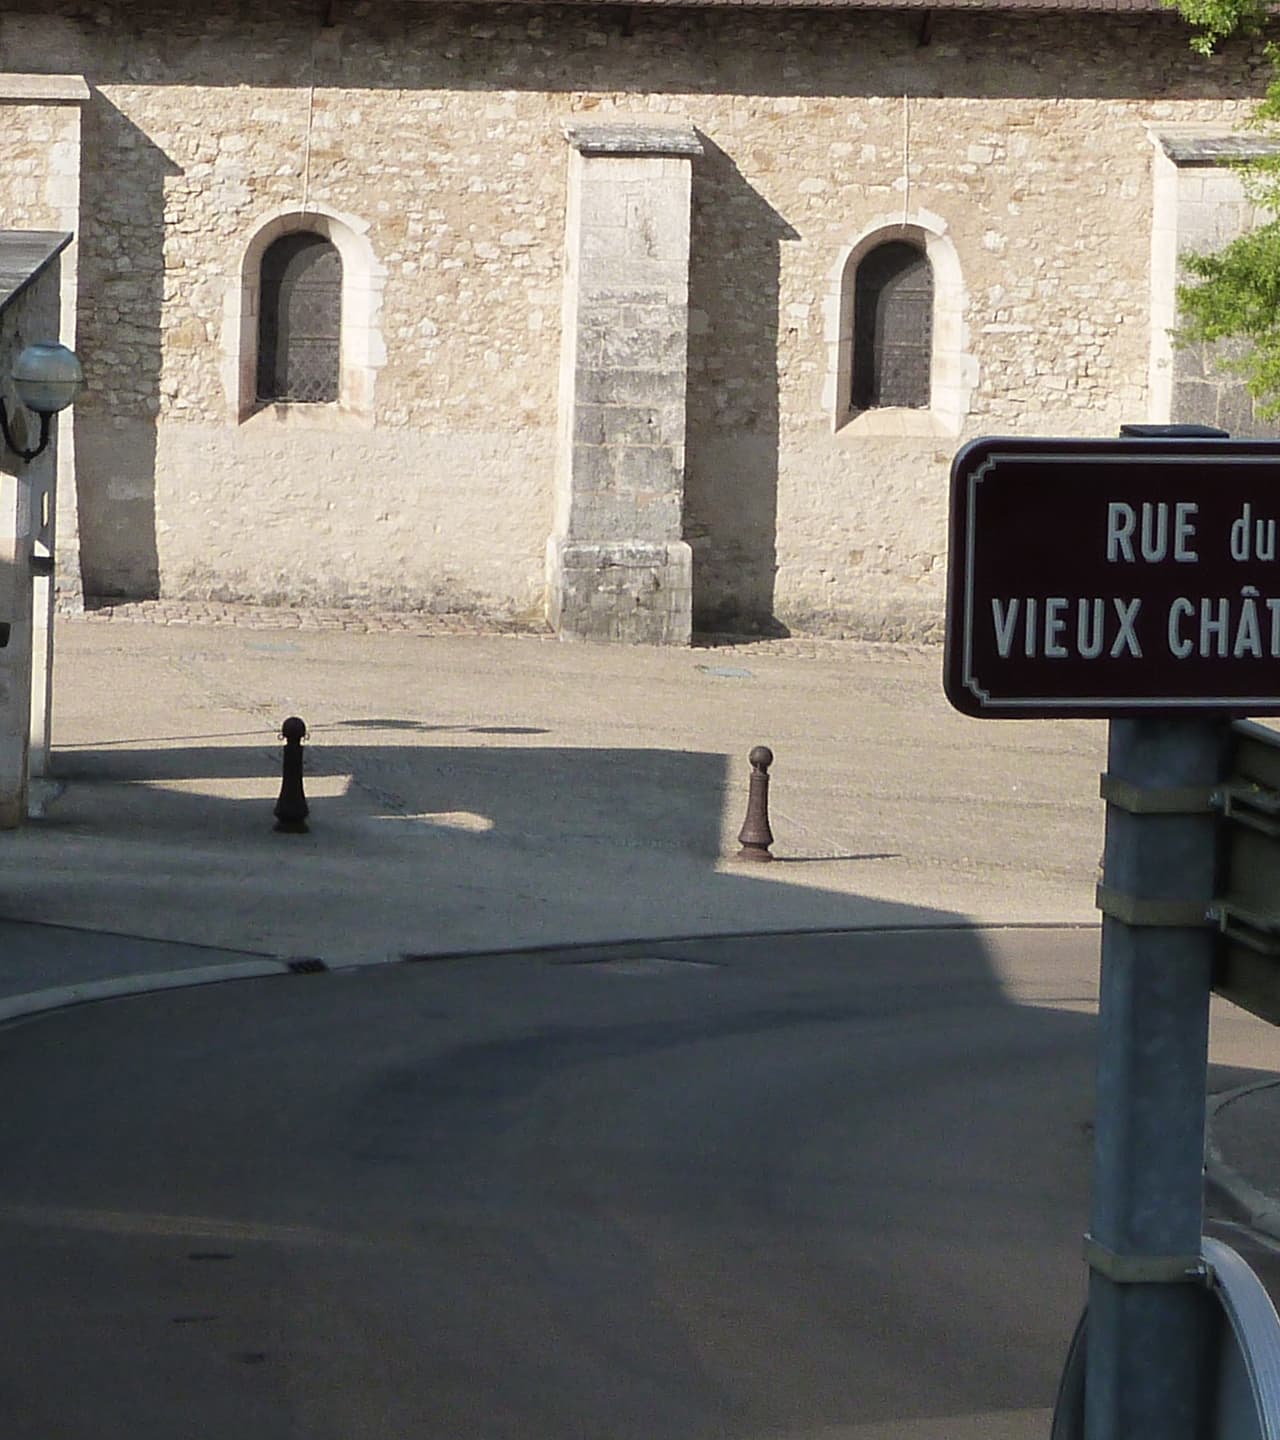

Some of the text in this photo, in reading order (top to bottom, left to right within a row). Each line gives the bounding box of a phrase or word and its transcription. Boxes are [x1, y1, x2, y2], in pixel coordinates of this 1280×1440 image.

[1106, 502, 1277, 563] RUE du
[991, 597, 1143, 659] VIEUX
